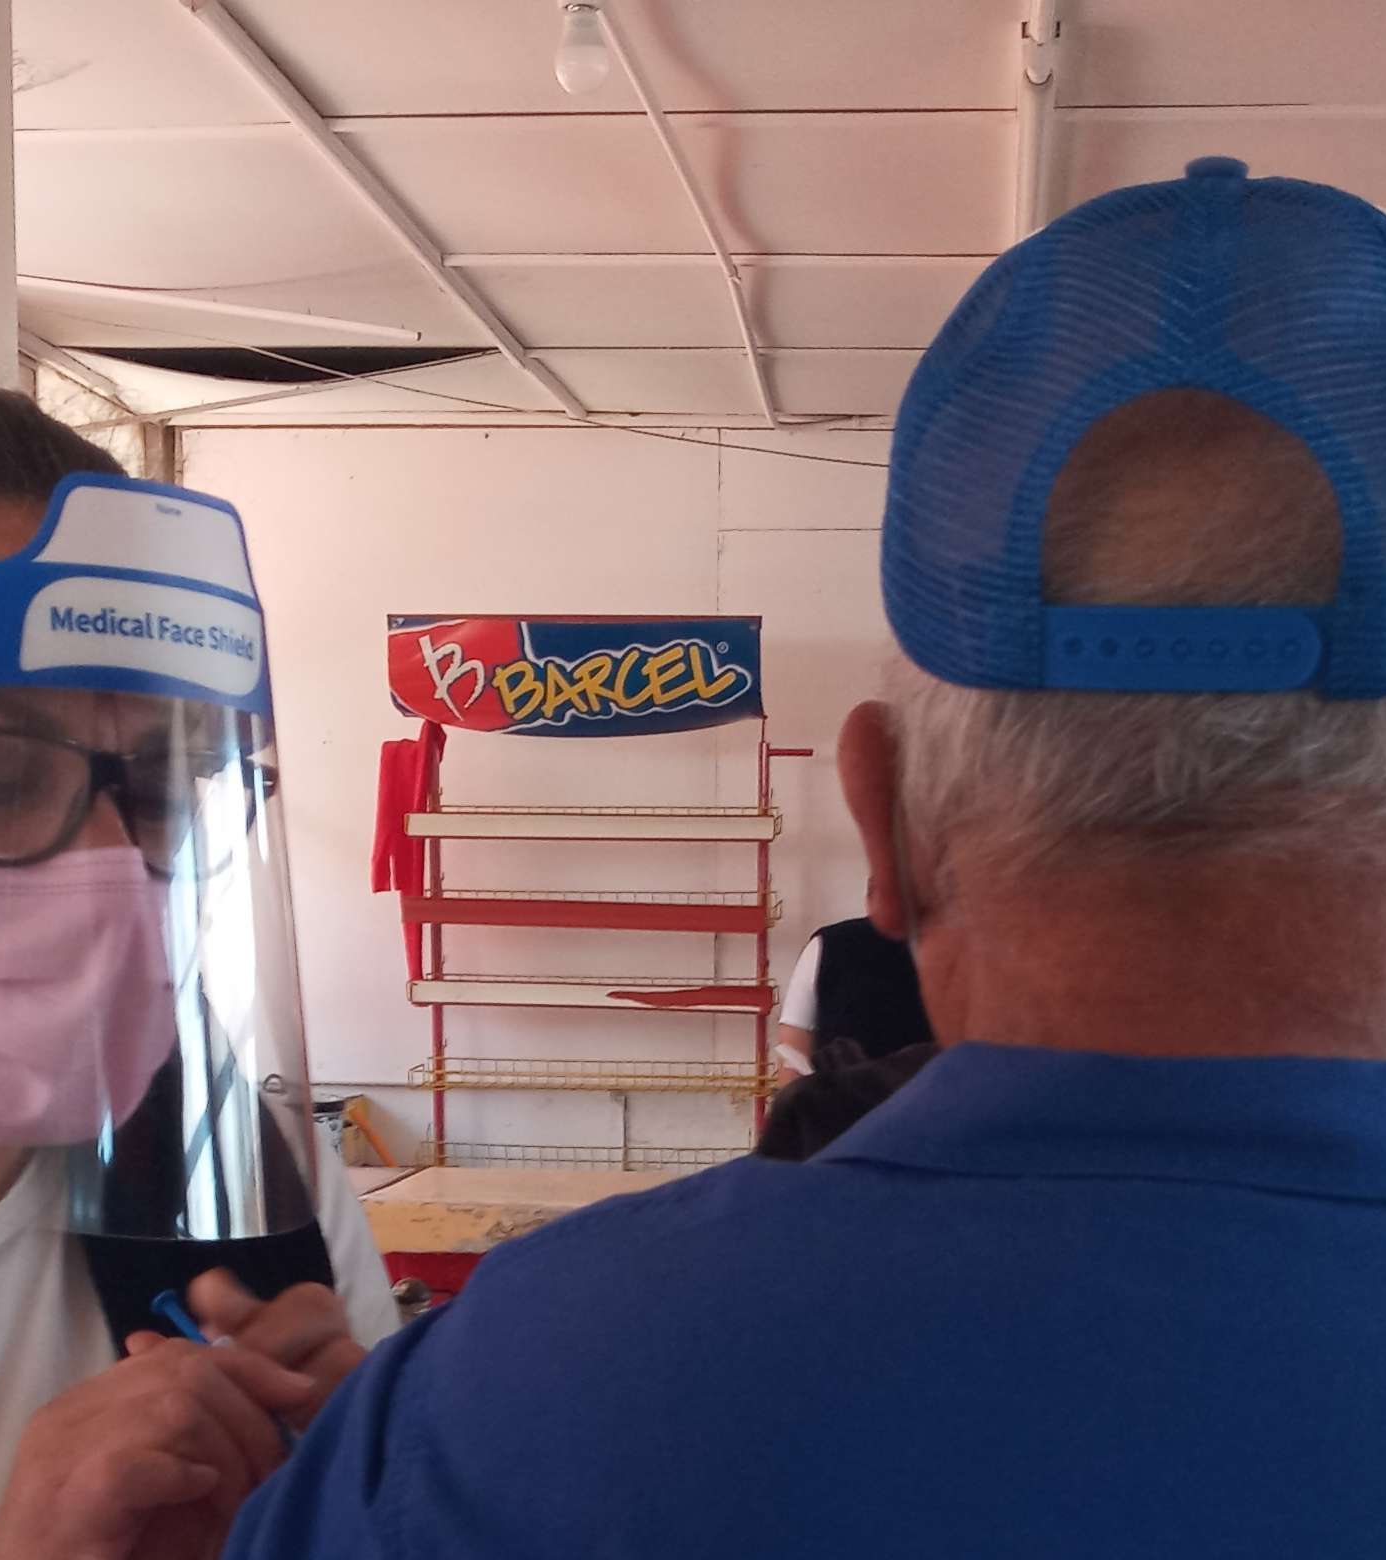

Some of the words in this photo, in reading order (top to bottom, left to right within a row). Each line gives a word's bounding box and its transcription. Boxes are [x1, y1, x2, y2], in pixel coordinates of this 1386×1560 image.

[50, 606, 154, 640] Medical
[156, 615, 205, 648] Face
[207, 625, 254, 661] Shield
[492, 643, 736, 721] BARCEL
